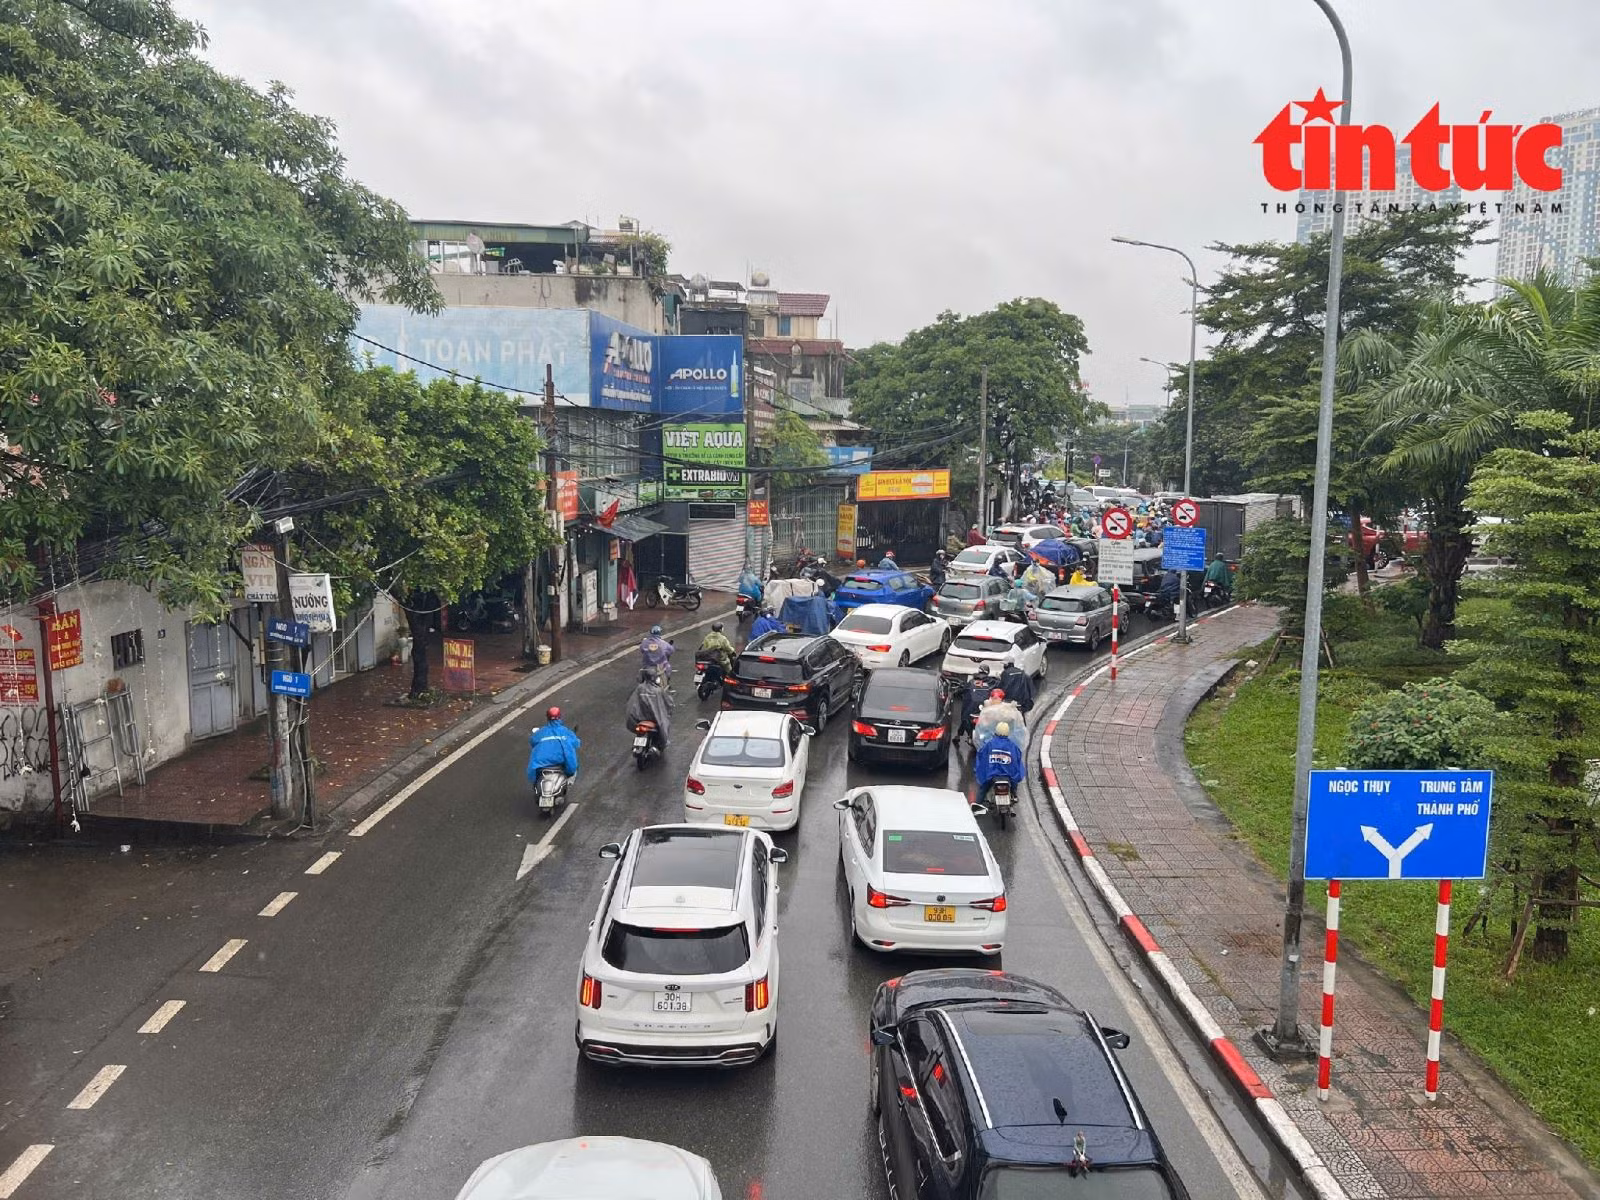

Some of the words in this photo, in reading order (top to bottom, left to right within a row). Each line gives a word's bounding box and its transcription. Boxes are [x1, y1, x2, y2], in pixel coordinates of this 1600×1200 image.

[669, 367, 728, 380] APOLLO
[665, 427, 700, 453] VIỆT
[703, 430, 743, 449] AQUA
[293, 593, 329, 609] NƯỚNG
[1328, 780, 1358, 796] NGỌC
[1363, 780, 1391, 796] THỤY
[1420, 780, 1456, 793] TRUNG
[1460, 777, 1483, 793] TÂM
[1417, 800, 1453, 816] THÀNH
[1457, 799, 1481, 816] PHỐ
[664, 992, 681, 1002] 30H
